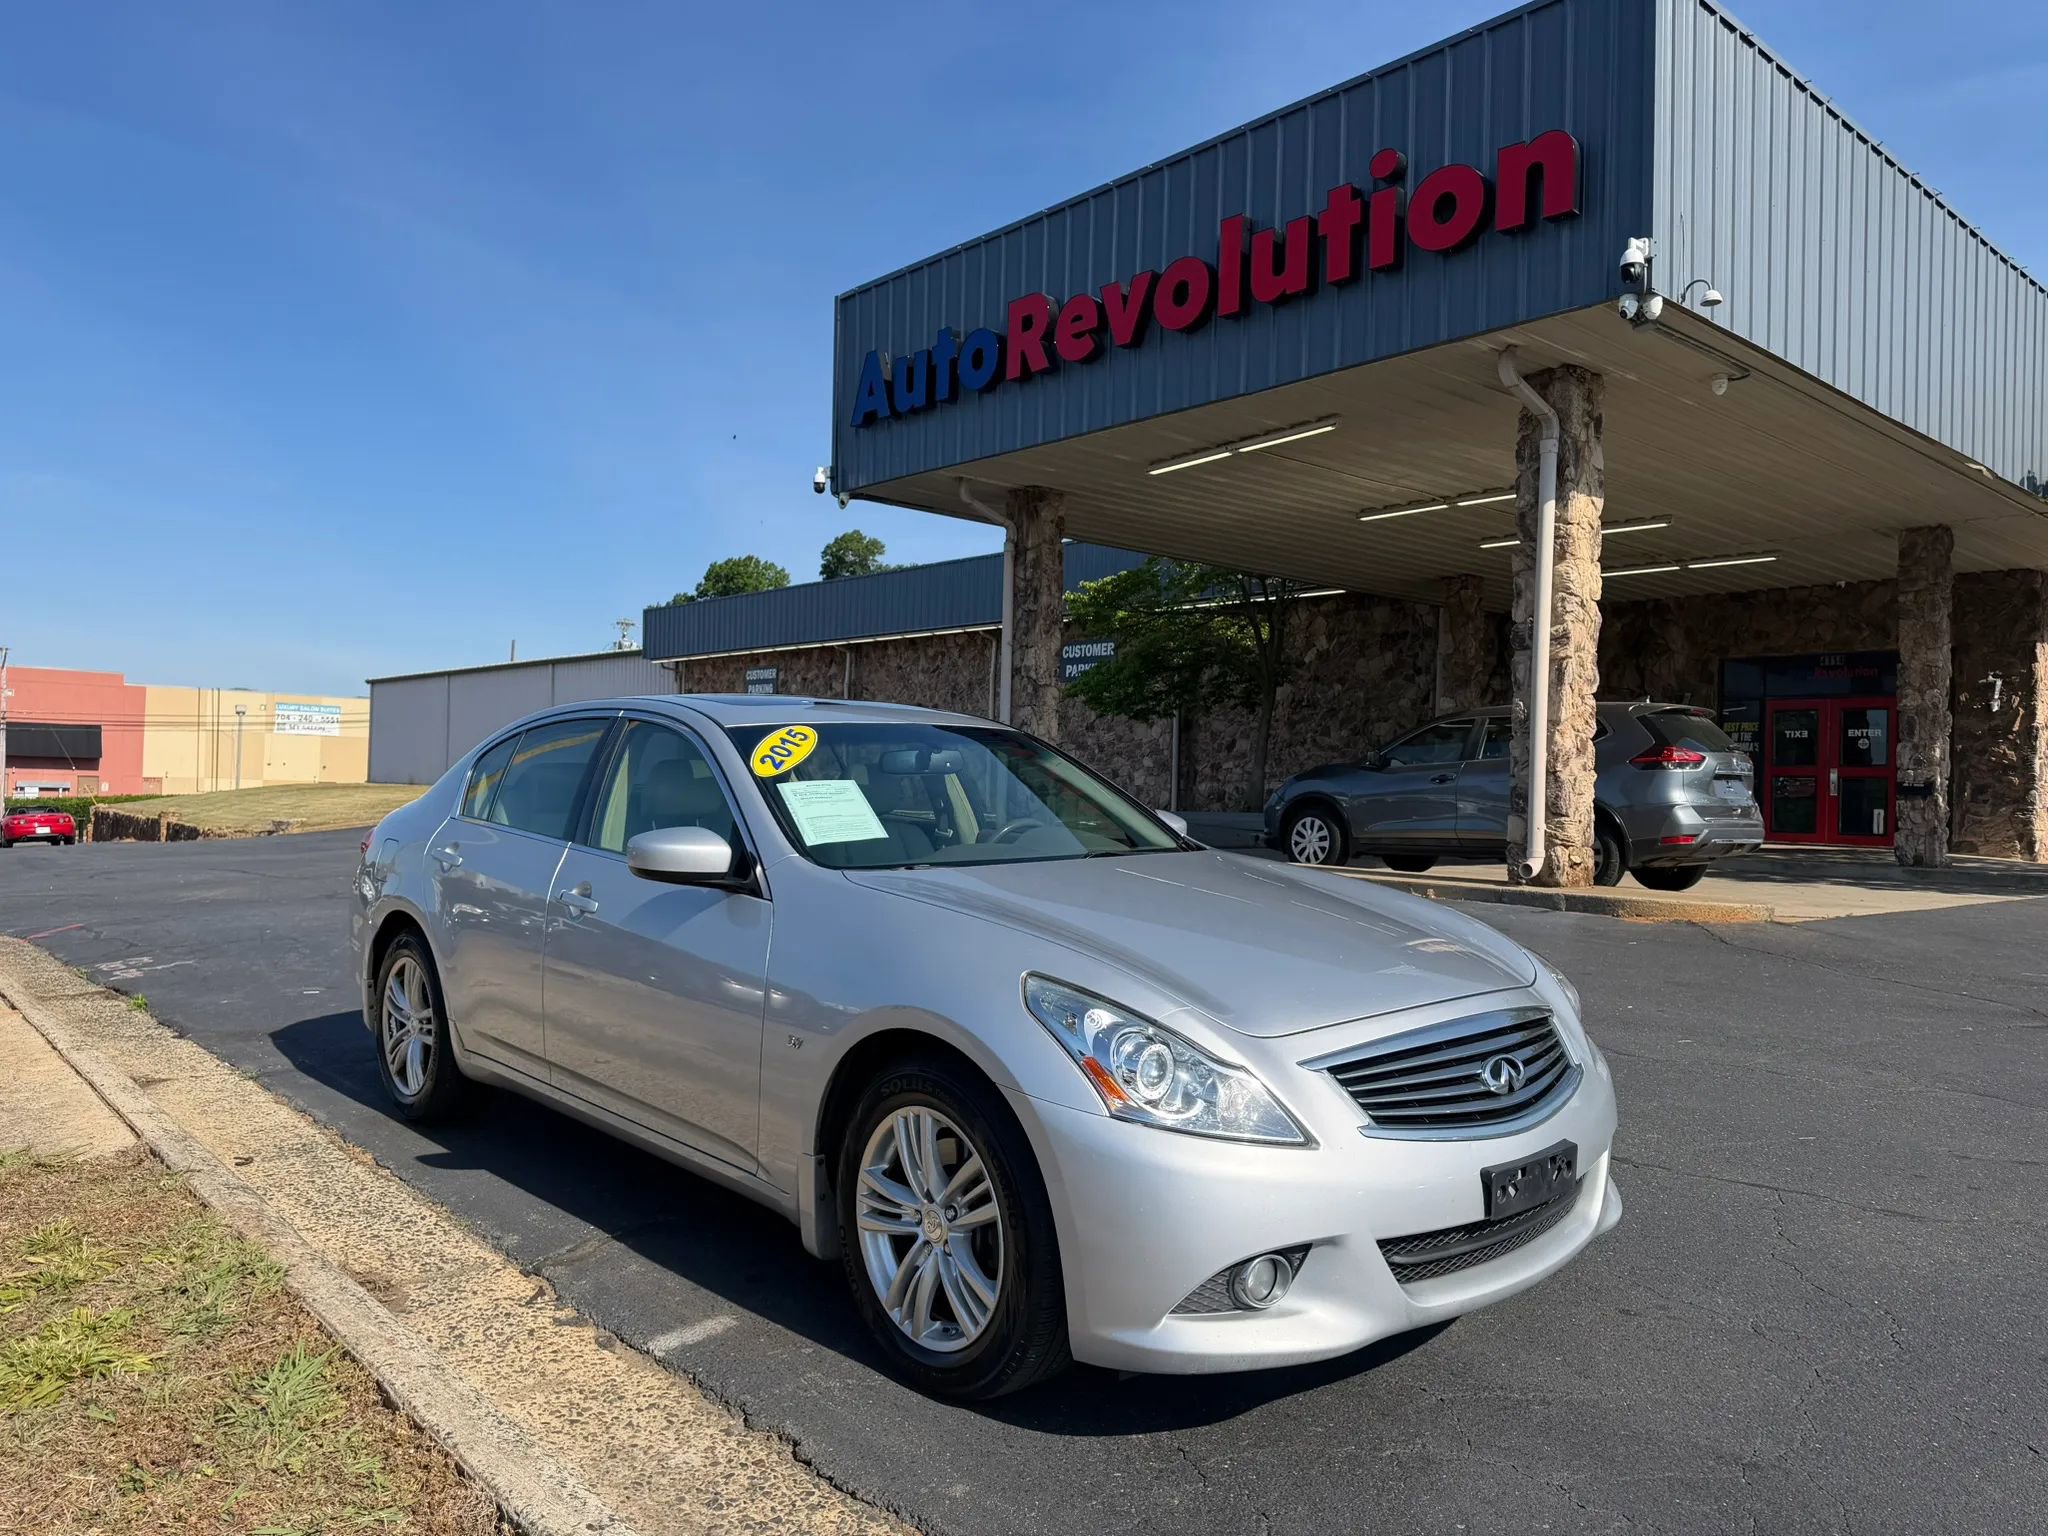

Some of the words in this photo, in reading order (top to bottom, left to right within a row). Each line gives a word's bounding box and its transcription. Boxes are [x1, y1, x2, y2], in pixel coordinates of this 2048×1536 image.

[1062, 642, 1115, 659] CUSTOMER
[746, 669, 777, 680] CUSTOMER
[748, 684, 774, 695] PARKING
[1723, 722, 1739, 732] BEST
[1741, 722, 1760, 732] PRICE
[1740, 732, 1752, 742] THE
[1847, 729, 1882, 737] ENTER
[759, 728, 810, 771] 2015
